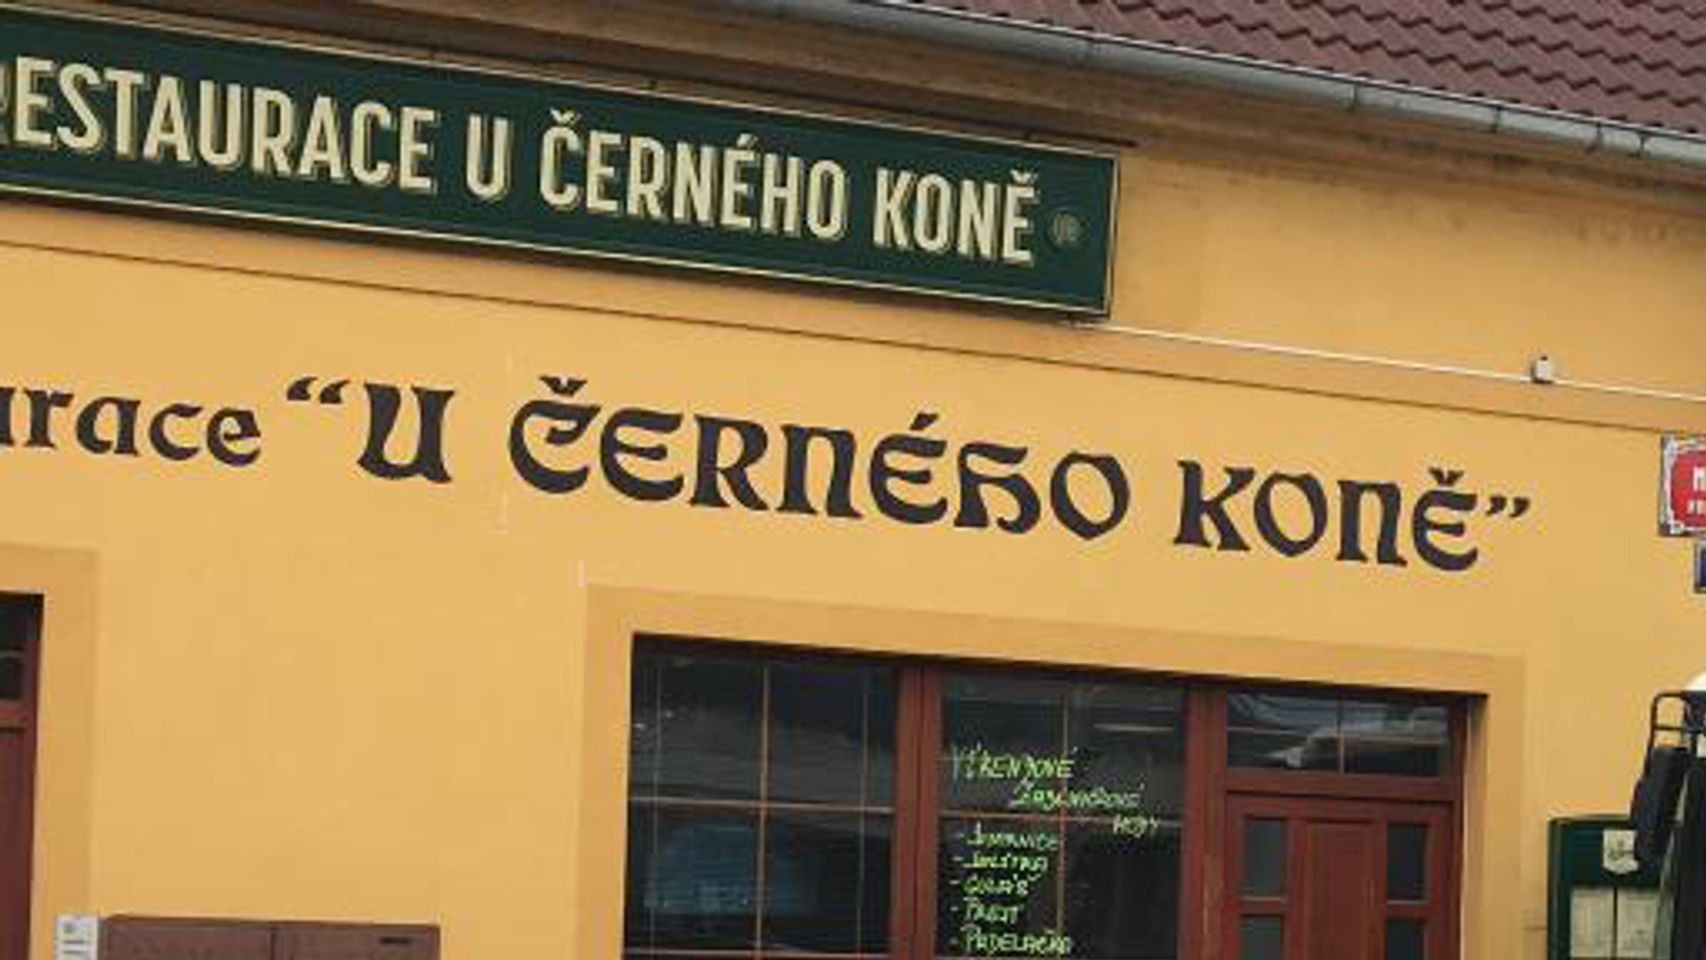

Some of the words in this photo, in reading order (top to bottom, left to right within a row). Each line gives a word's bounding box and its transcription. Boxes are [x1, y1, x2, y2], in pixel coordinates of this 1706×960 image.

[0, 55, 437, 190] ESTAURACE
[466, 115, 510, 199] U
[541, 109, 847, 242] ČERNÉHO
[874, 168, 1038, 264] KONĚ
[509, 377, 1131, 541] ČERNÉHO
